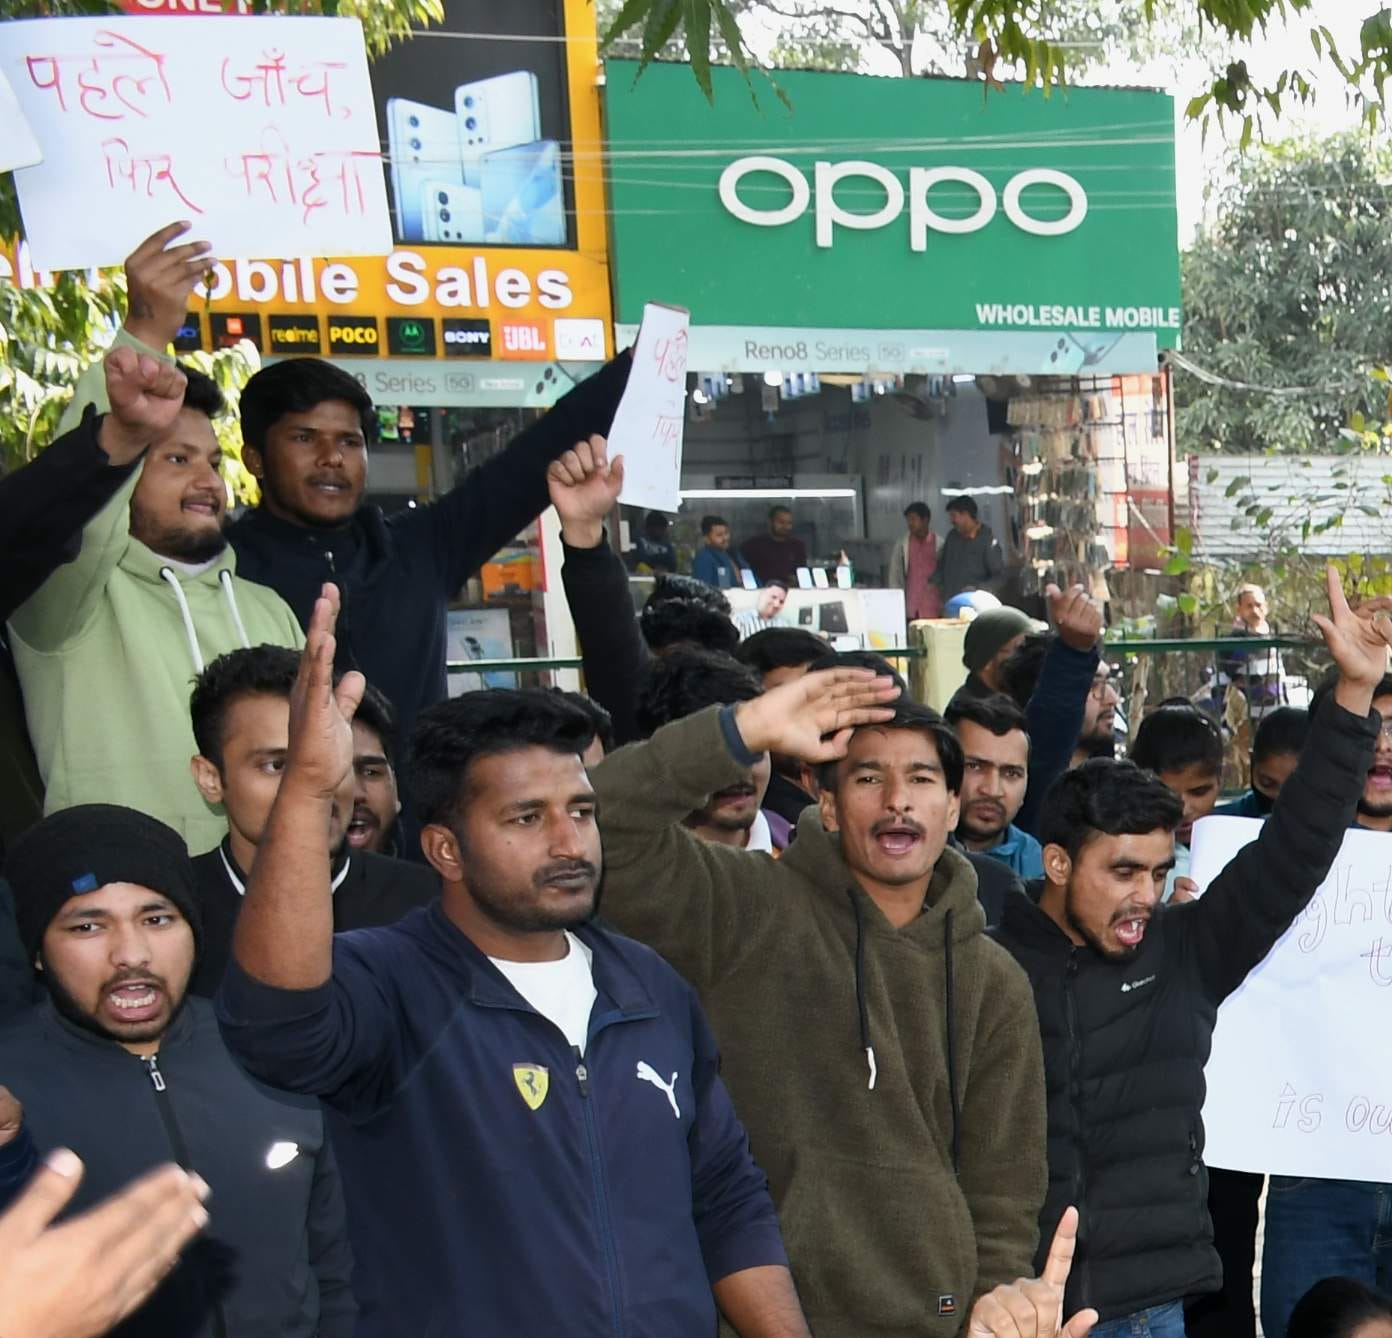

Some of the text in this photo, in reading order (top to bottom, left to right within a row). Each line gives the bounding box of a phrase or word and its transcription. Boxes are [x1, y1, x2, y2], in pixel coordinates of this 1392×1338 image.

[718, 155, 1088, 252] oppo
[194, 251, 574, 309] obile Sales
[975, 303, 1181, 328] WHOLESALE MOBILE
[330, 326, 377, 344] POCO
[444, 331, 490, 344] SONY
[506, 326, 546, 351] JBL
[744, 339, 808, 361] Reno8
[815, 342, 870, 361] Series
[375, 372, 436, 393] Series
